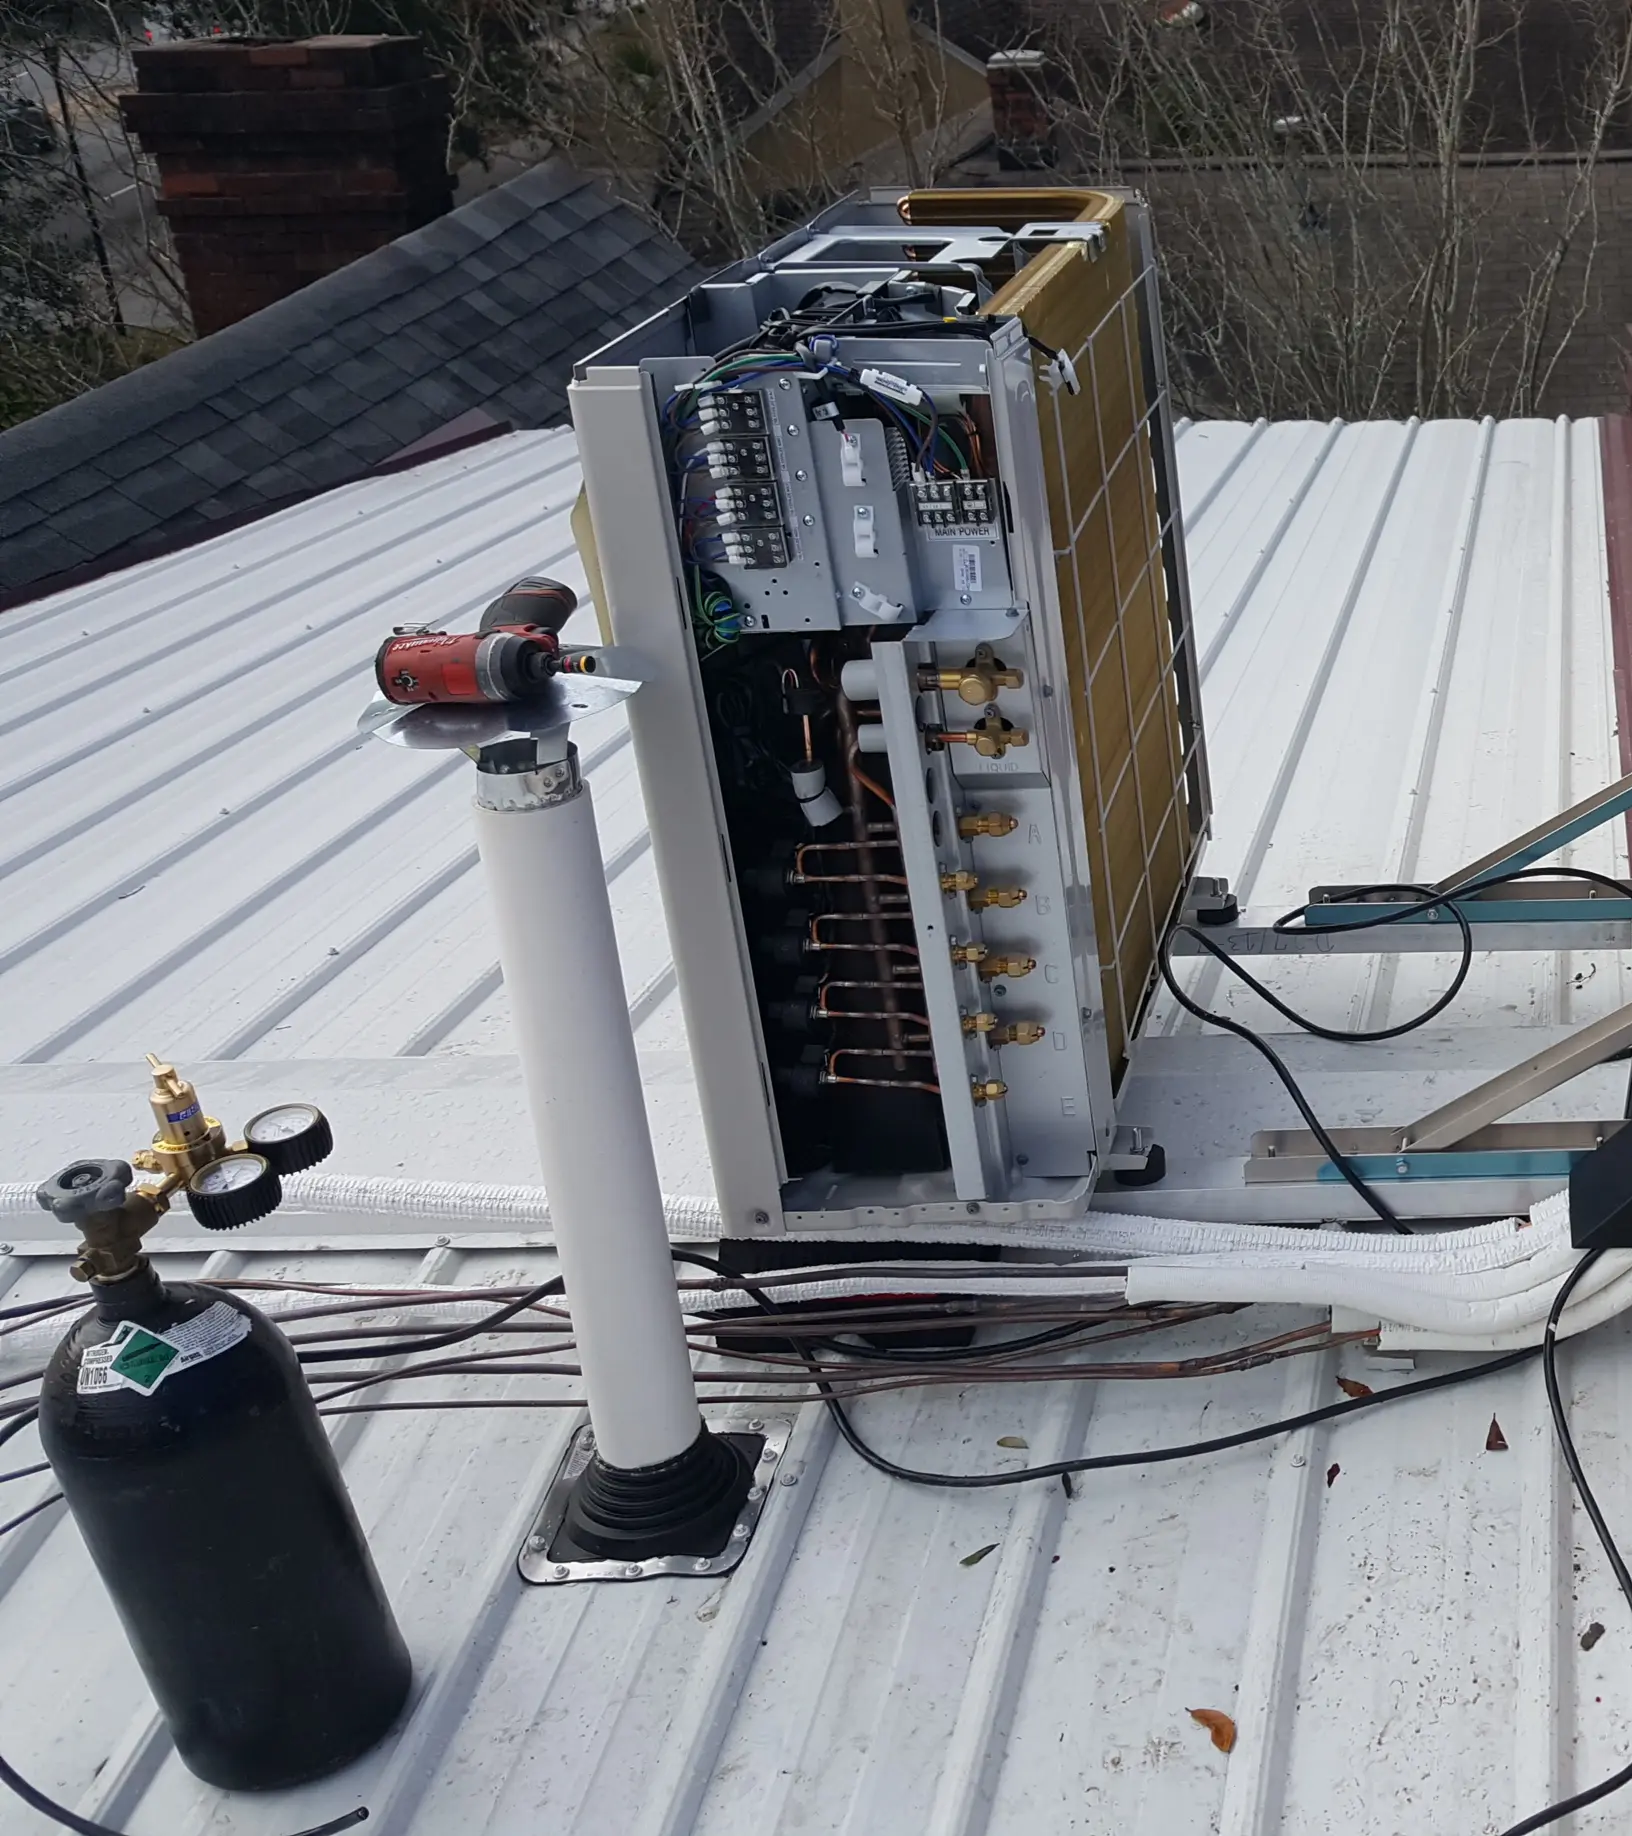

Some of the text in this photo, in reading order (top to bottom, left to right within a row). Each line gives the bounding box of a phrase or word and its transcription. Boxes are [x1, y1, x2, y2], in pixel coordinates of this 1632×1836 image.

[935, 527, 990, 536] MAIN POWER
[1028, 823, 1041, 844] A
[1036, 895, 1050, 915] B
[1045, 964, 1058, 983] C
[1053, 1030, 1067, 1051] D
[1061, 1096, 1076, 1115] E
[80, 1366, 108, 1386] UN1066
